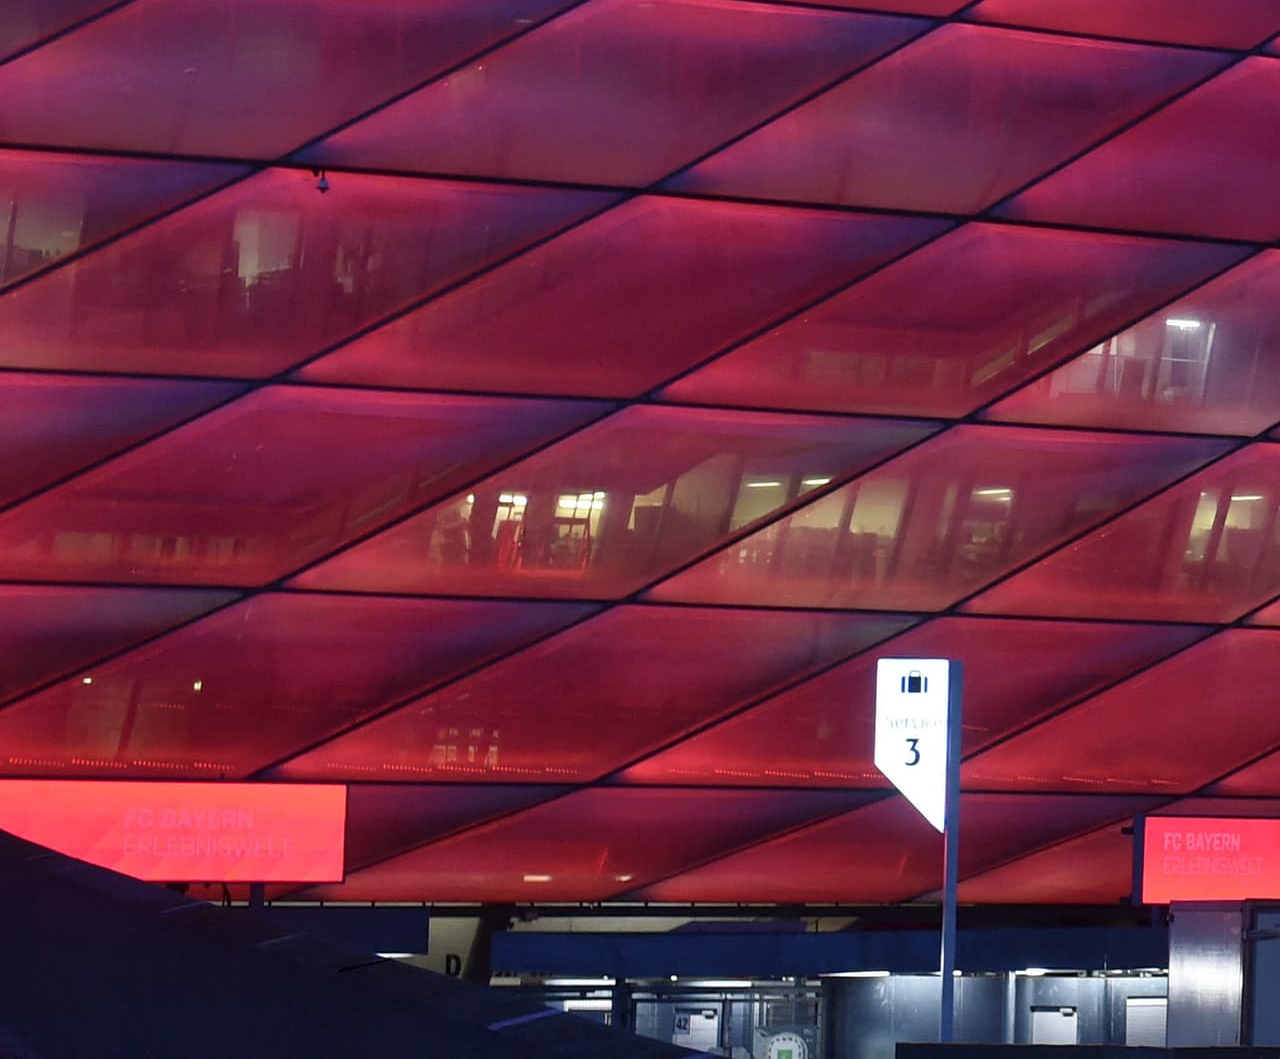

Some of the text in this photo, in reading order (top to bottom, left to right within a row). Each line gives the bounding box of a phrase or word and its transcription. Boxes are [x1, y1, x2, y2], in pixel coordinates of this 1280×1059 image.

[905, 738, 920, 766] 3
[159, 808, 254, 830] BAYERN
[1164, 831, 1241, 851] FC BAYERN
[676, 1016, 688, 1031] 42
